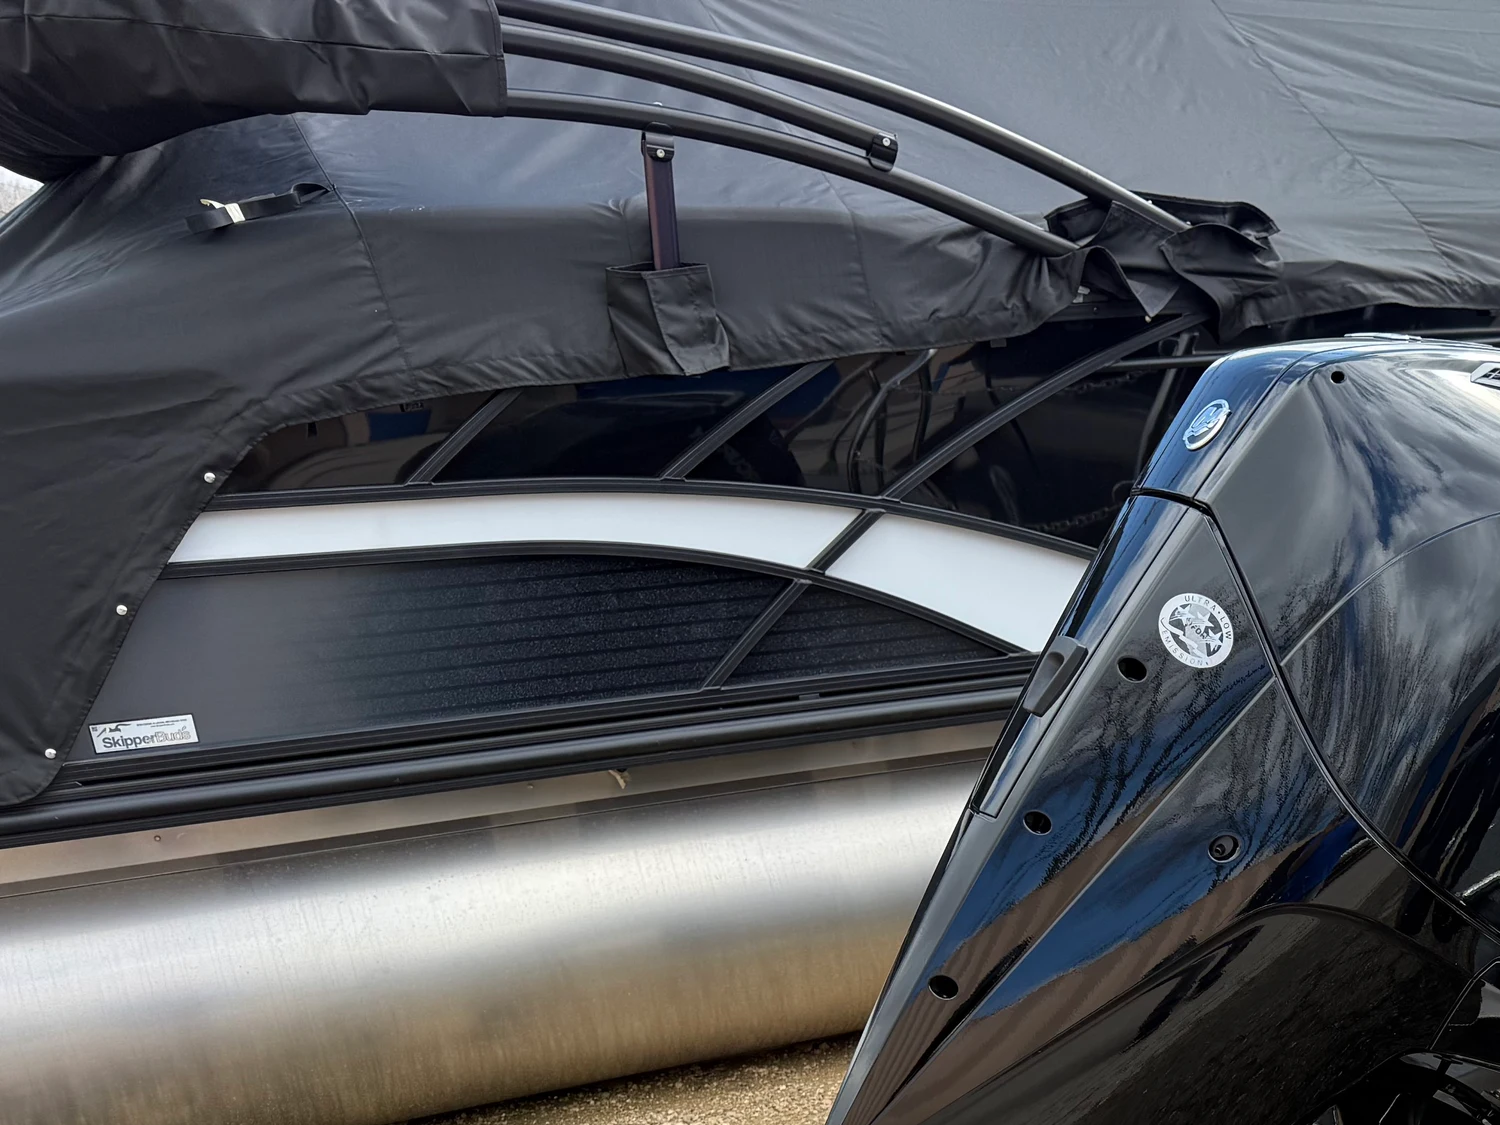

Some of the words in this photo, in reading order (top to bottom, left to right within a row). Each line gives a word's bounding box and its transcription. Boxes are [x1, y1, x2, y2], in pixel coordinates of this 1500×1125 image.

[1184, 595, 1217, 612] ULTRA
[1220, 616, 1233, 640] LOW
[1161, 630, 1203, 666] EMISSION
